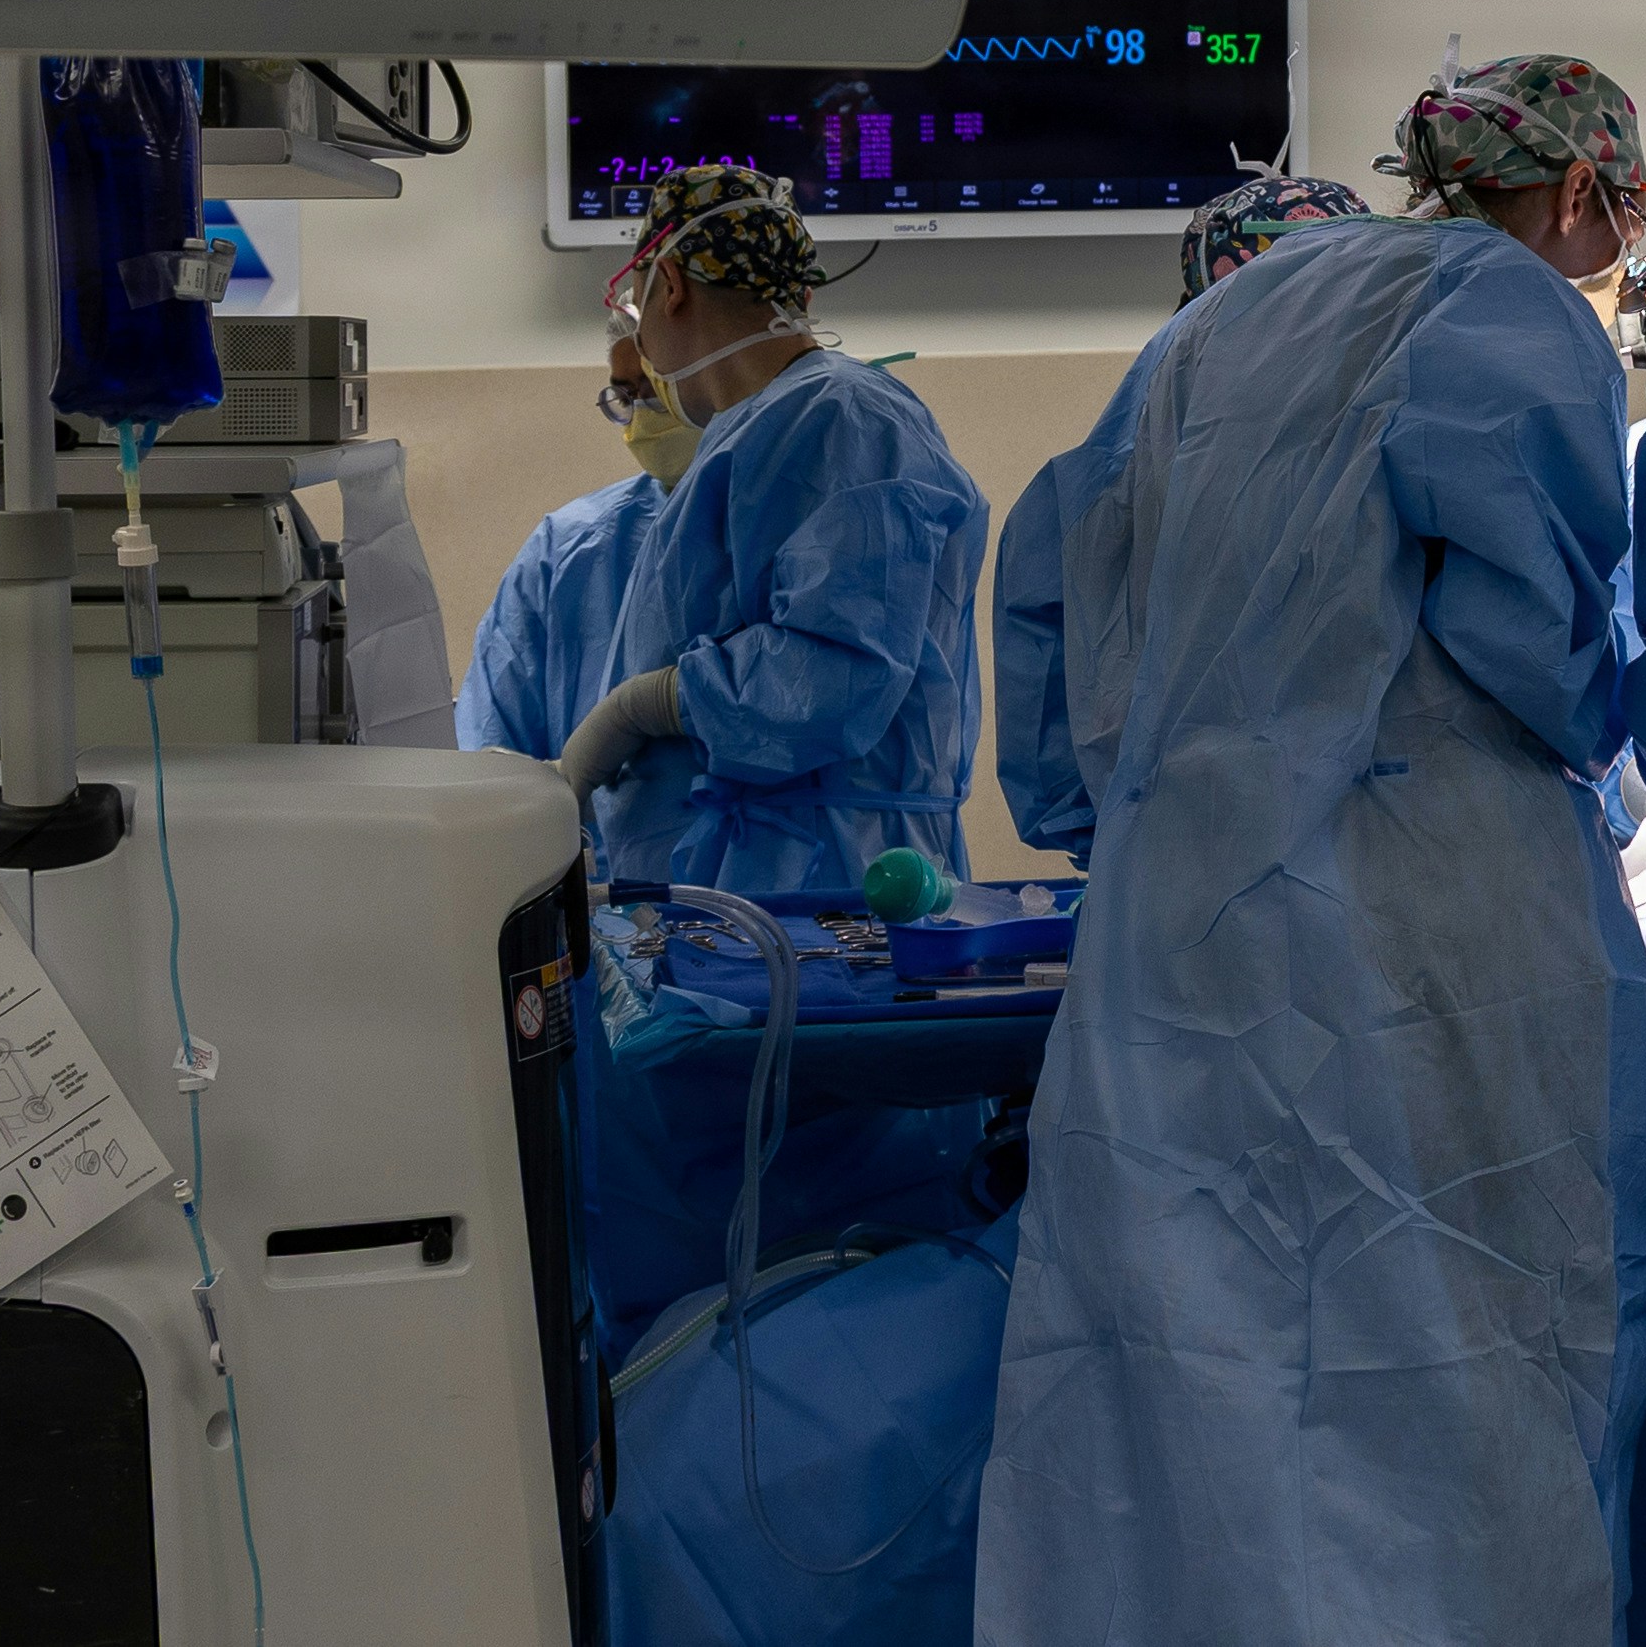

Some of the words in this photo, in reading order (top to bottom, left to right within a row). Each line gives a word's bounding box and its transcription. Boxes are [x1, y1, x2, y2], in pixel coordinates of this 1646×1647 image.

[1106, 29, 1146, 64] 98
[1206, 33, 1261, 64] 35.7
[929, 220, 938, 232] 5
